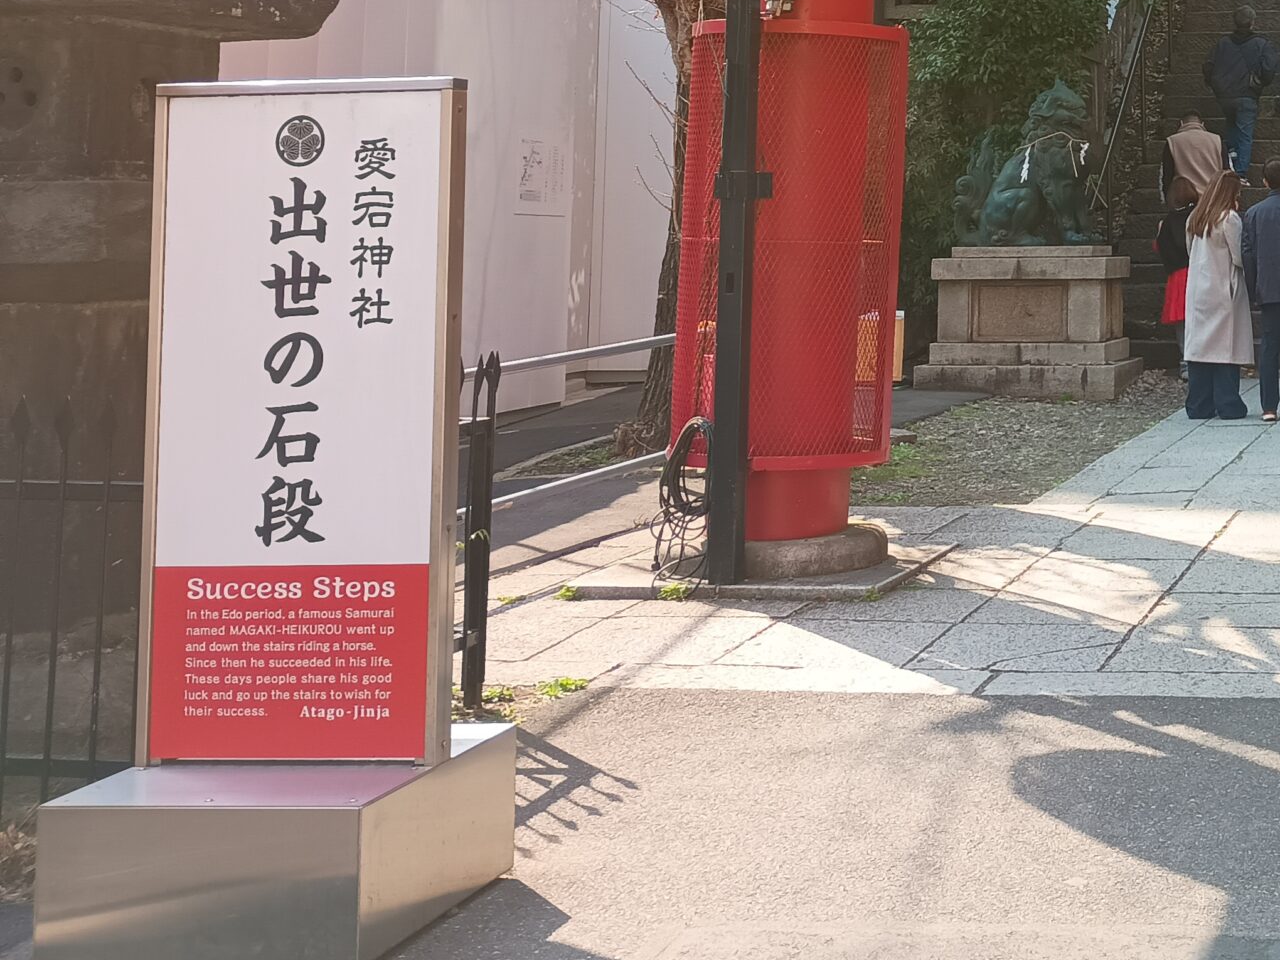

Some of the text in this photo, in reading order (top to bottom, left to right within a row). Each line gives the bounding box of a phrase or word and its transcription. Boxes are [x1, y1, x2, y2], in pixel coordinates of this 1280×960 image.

[349, 137, 396, 329] 愛宕神社
[254, 176, 332, 547] 出世の石段
[187, 576, 395, 602] Success Steps
[186, 609, 197, 620] In
[200, 609, 219, 620] the
[221, 609, 243, 620] Edo
[288, 611, 295, 619] a
[298, 608, 342, 619] famous
[345, 607, 395, 619] Samurai
[186, 623, 395, 636] named MAGAKI-HEIKUROU went up
[185, 640, 377, 653] and down the stairs riding a horse.
[185, 656, 393, 668] Since then he succeeded in his life.
[184, 672, 393, 686] These days people share his good
[184, 688, 392, 702] luck and go up the stairs to wish for
[184, 704, 390, 721] their success. Atago-Jinja
